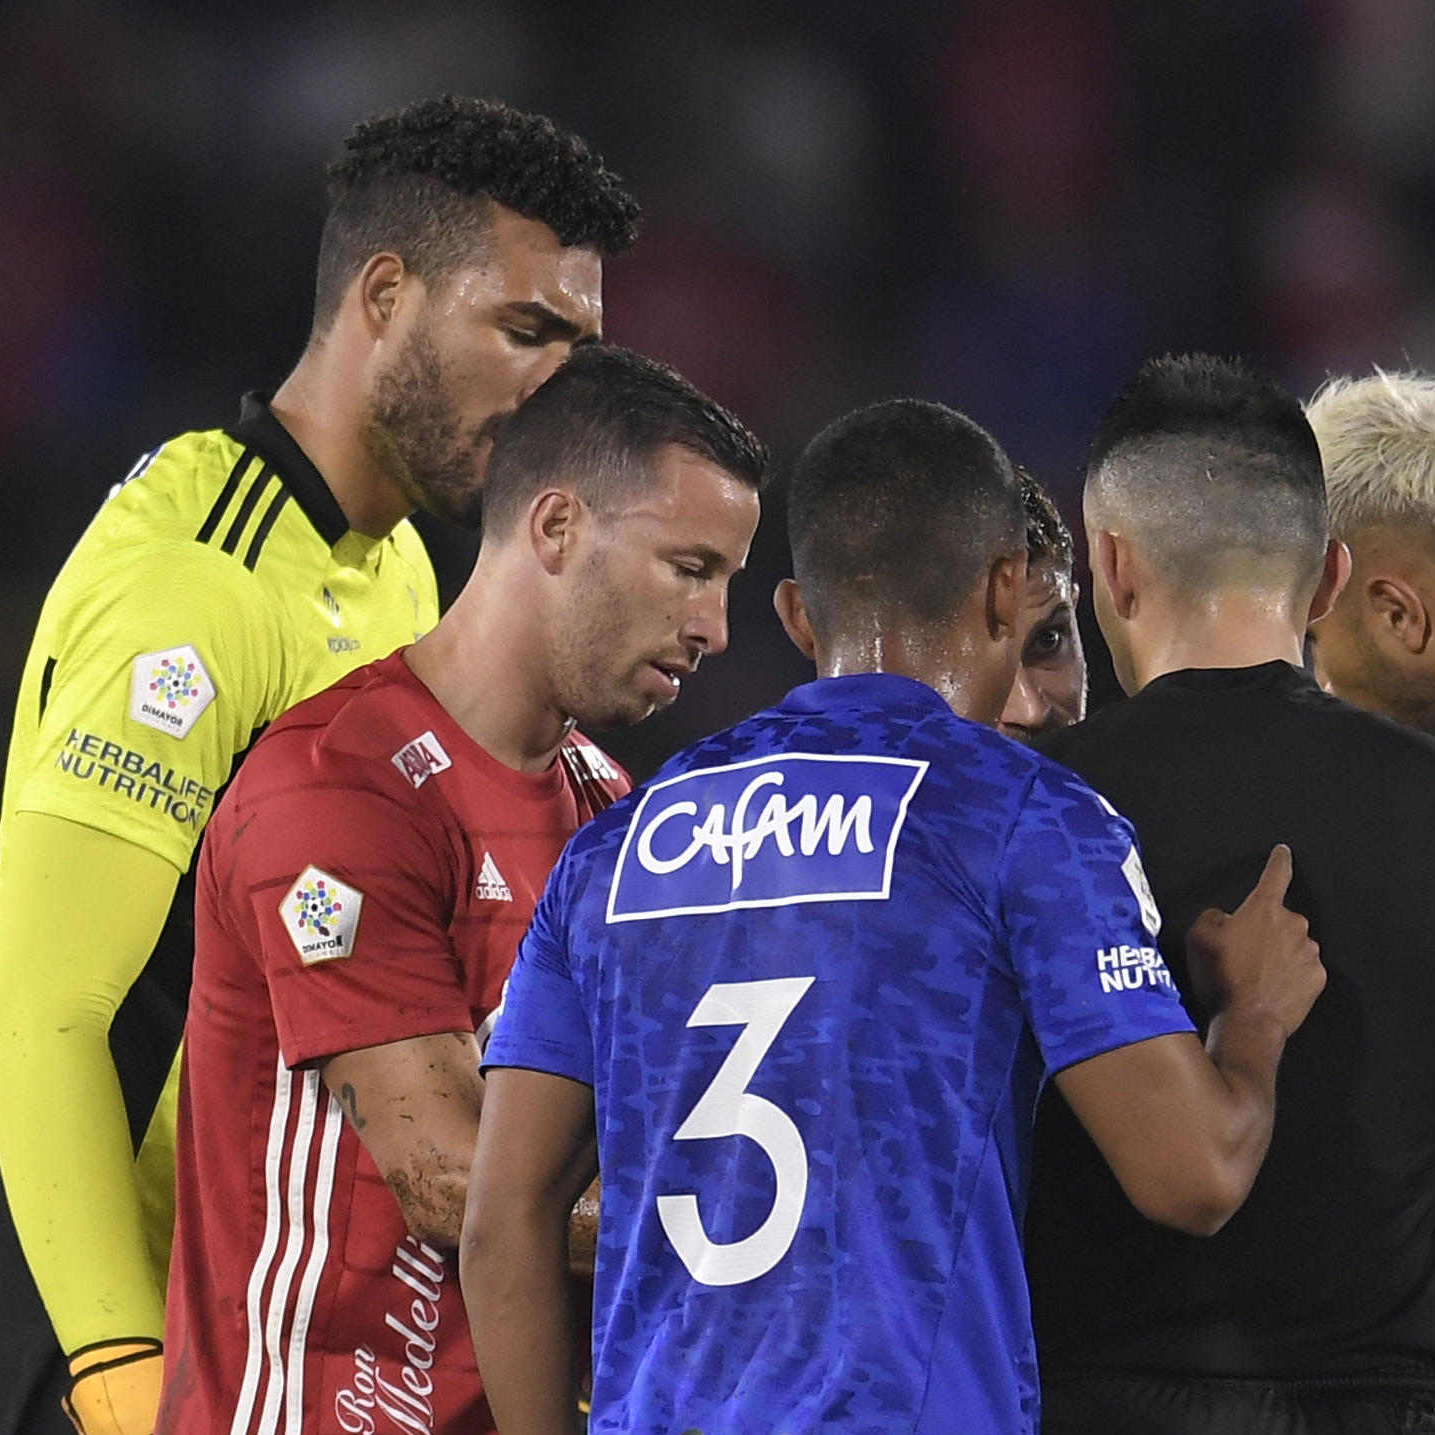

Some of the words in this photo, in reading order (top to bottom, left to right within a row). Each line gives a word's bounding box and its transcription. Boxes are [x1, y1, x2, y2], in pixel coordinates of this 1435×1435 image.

[142, 703, 183, 727] DIMAYOR
[55, 750, 200, 830] NUTRITION
[65, 728, 213, 809] HERBALIFE
[656, 976, 815, 1286] 3
[335, 1343, 376, 1435] Ron
